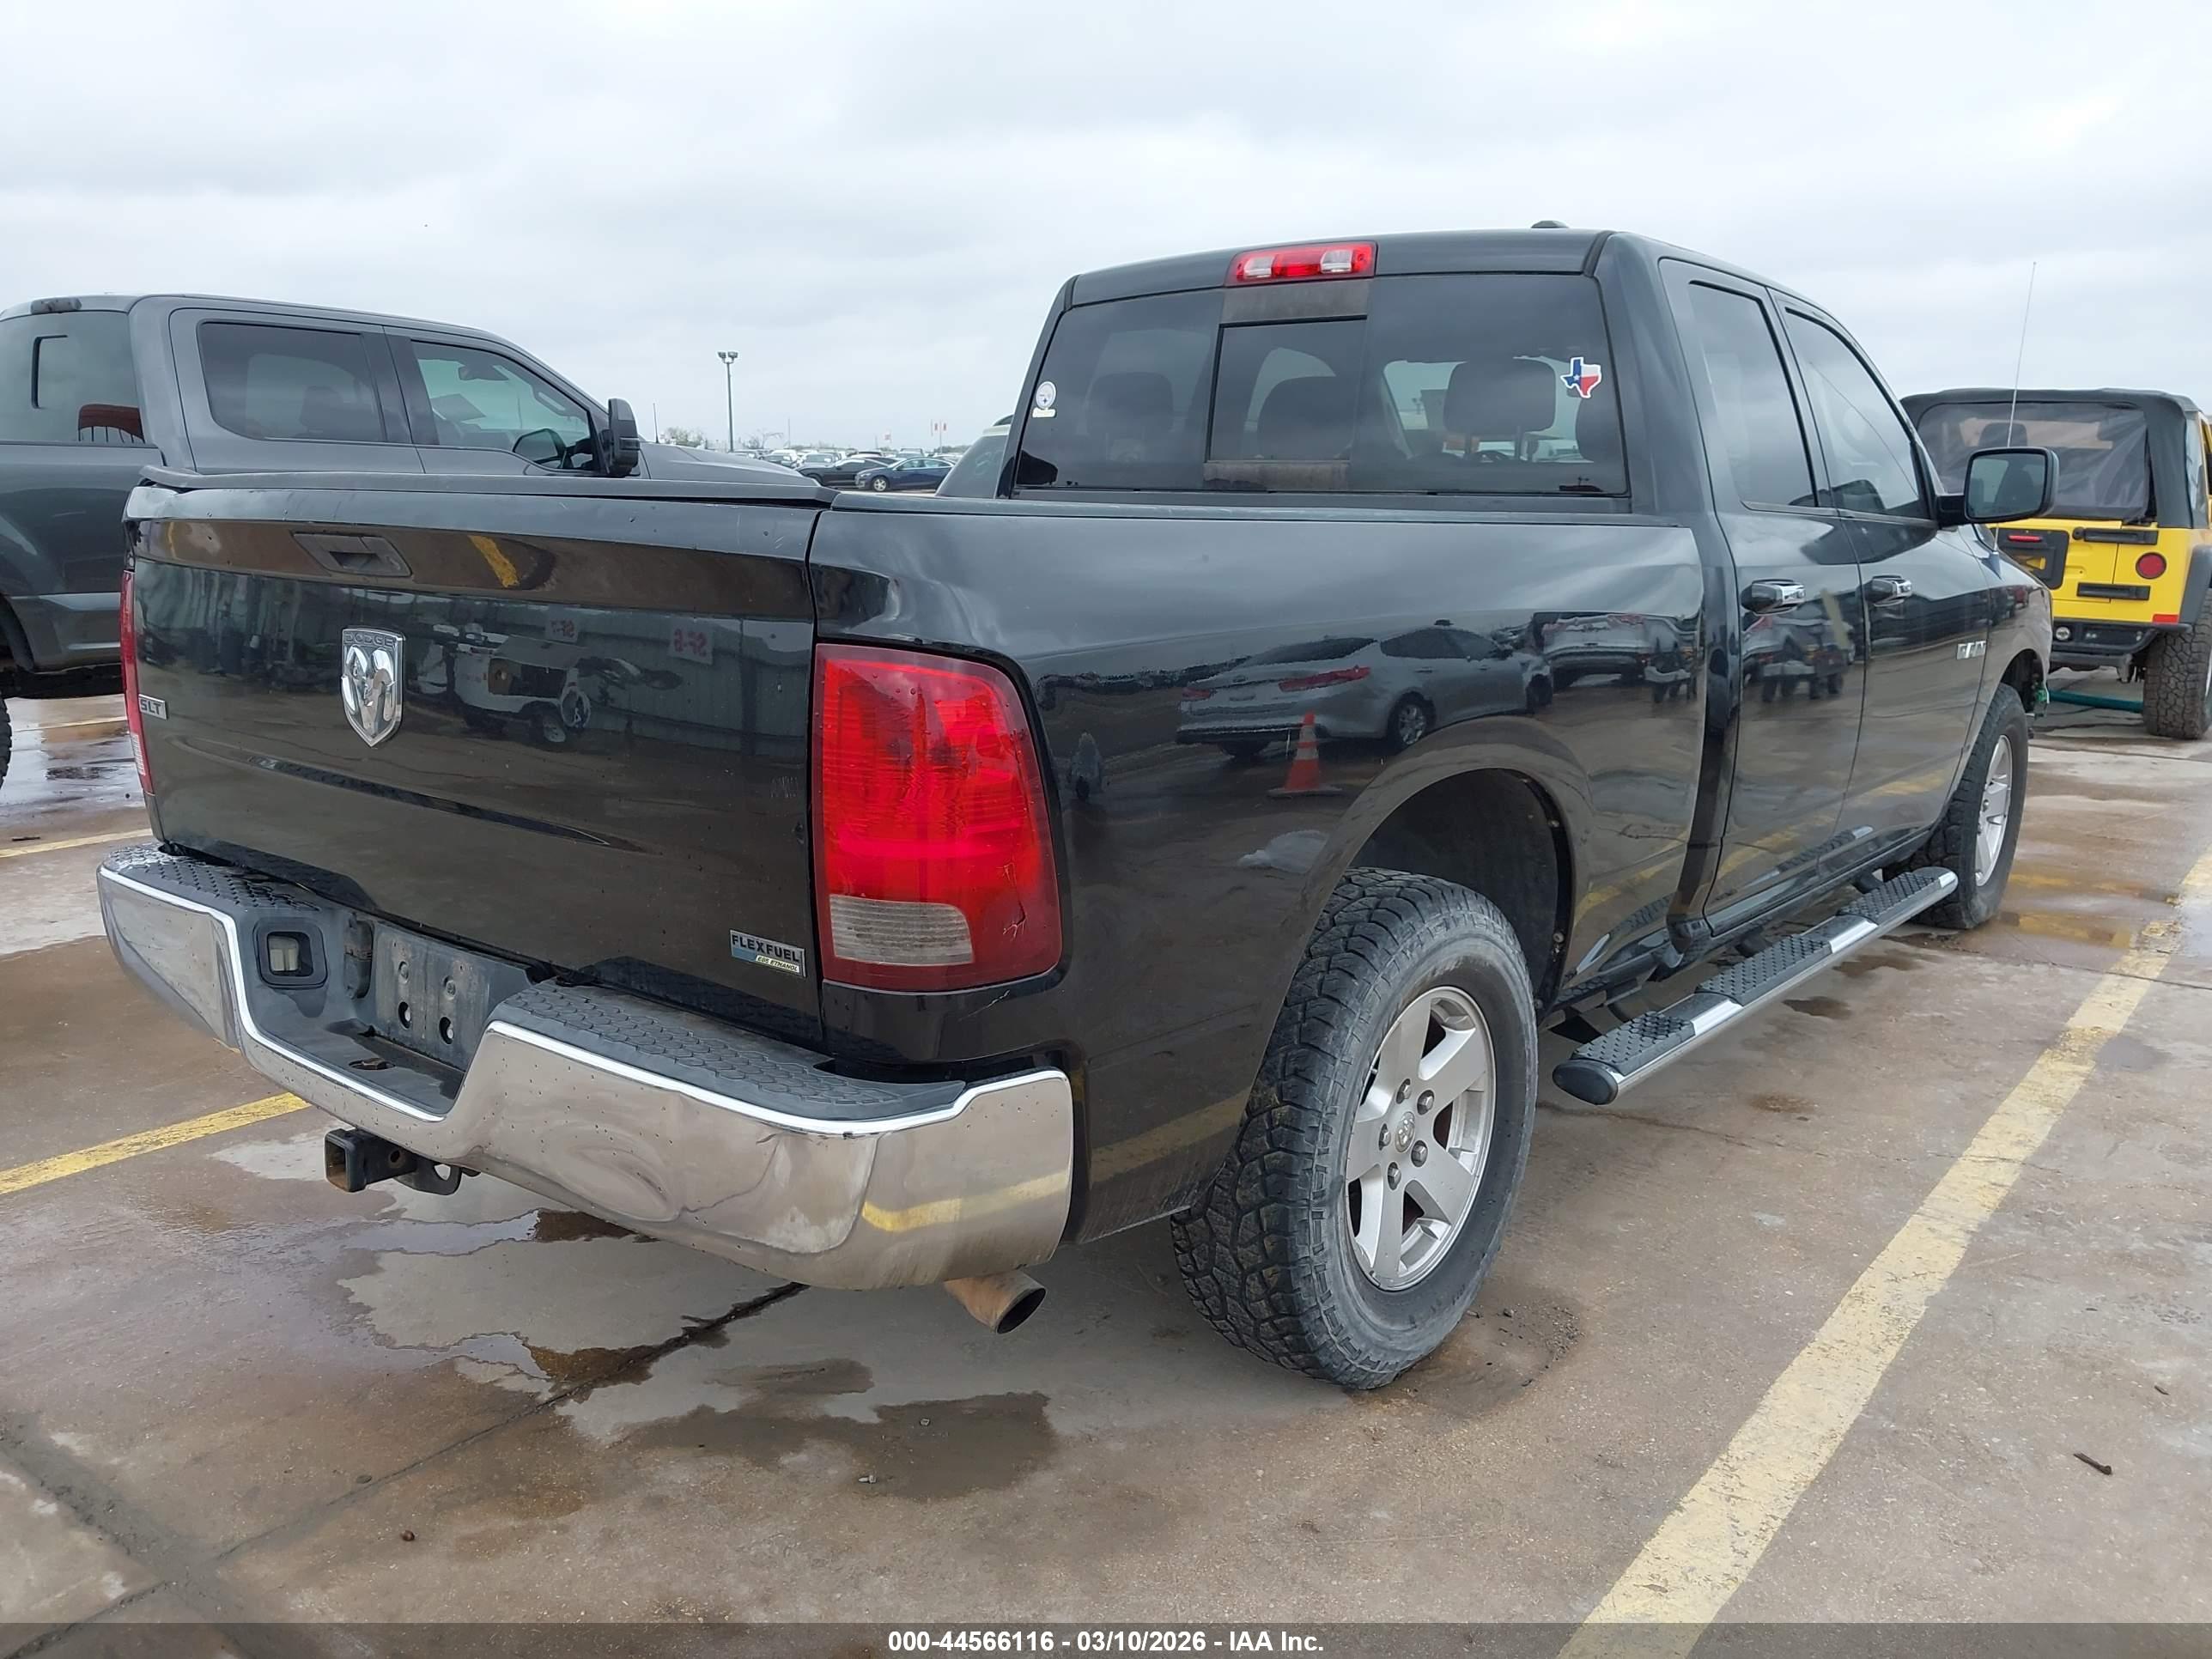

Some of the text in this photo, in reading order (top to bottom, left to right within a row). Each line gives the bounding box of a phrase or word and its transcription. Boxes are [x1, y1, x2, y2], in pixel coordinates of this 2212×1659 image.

[344, 633, 394, 647] DODGE
[140, 699, 161, 715] SLT
[732, 934, 800, 962] FLEXFUEL
[769, 960, 799, 972] ETHANOL
